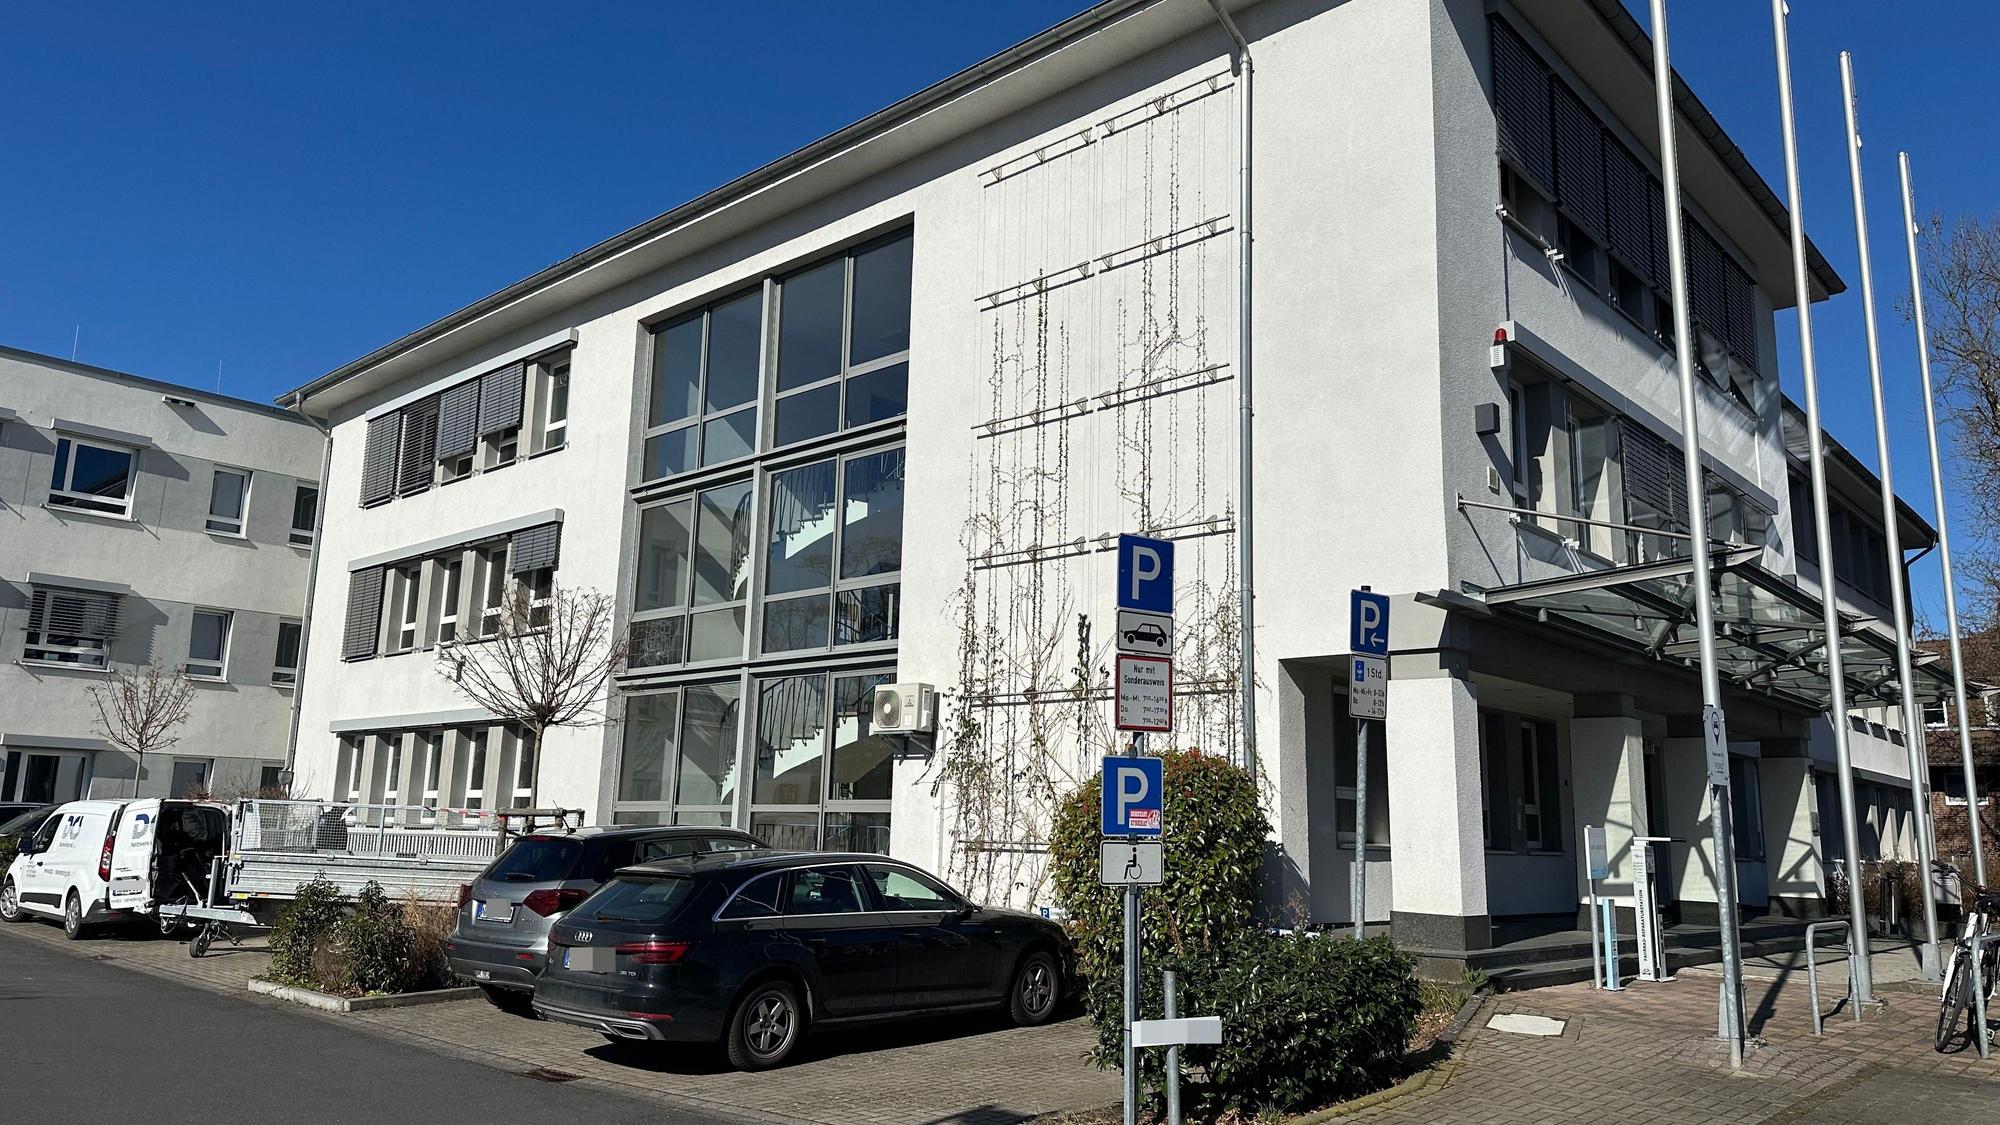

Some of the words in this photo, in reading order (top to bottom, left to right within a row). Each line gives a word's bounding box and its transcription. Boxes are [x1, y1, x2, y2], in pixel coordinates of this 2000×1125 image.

[1131, 545, 1161, 600] P
[1360, 600, 1380, 645] P
[1123, 675, 1165, 686] Sonderausweis
[1133, 664, 1143, 673] Nur
[1146, 666, 1155, 674] mit
[1117, 767, 1149, 825] P
